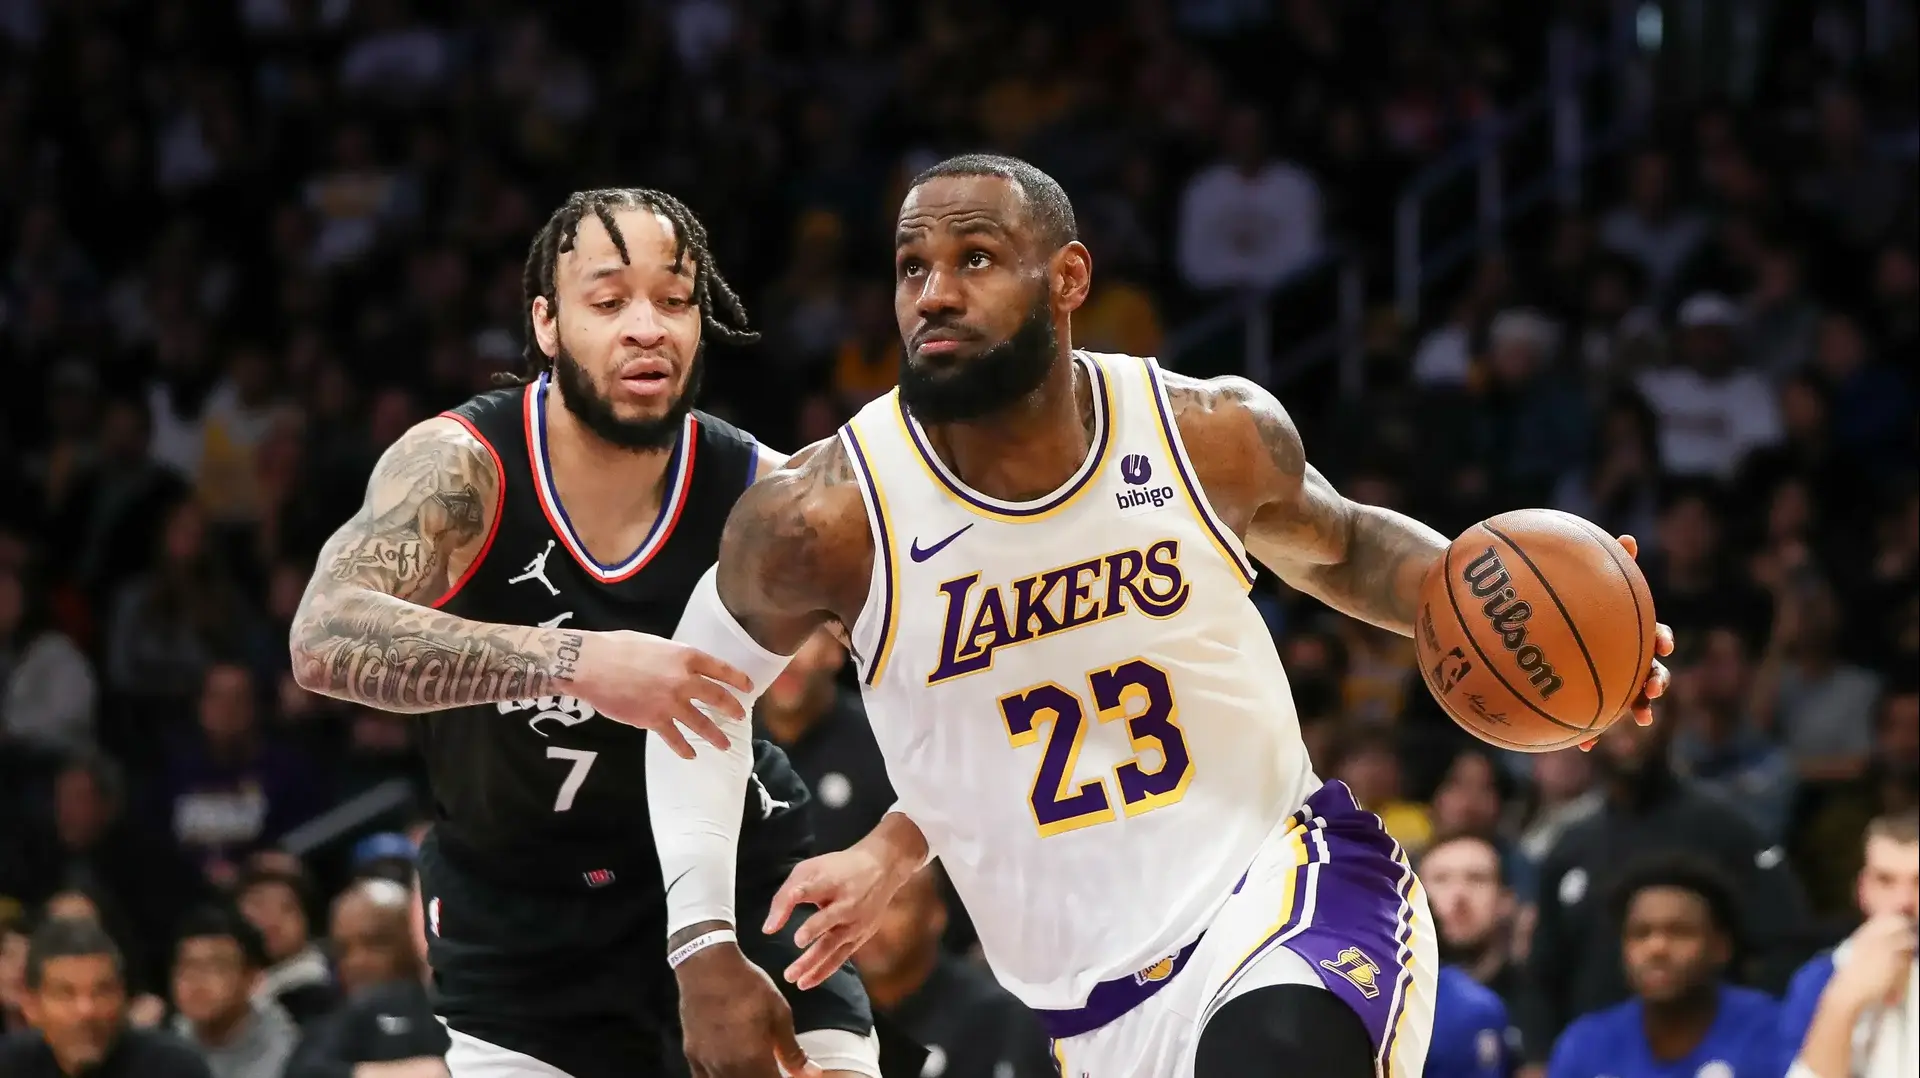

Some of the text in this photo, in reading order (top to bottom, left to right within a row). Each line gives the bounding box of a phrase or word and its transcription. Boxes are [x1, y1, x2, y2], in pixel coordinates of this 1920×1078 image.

[1115, 486, 1174, 510] bibigo
[925, 538, 1192, 688] LAKERS
[1462, 544, 1564, 701] Wilson
[545, 746, 598, 812] 7
[995, 655, 1196, 838] 23
[670, 938, 705, 964] PROMISE
